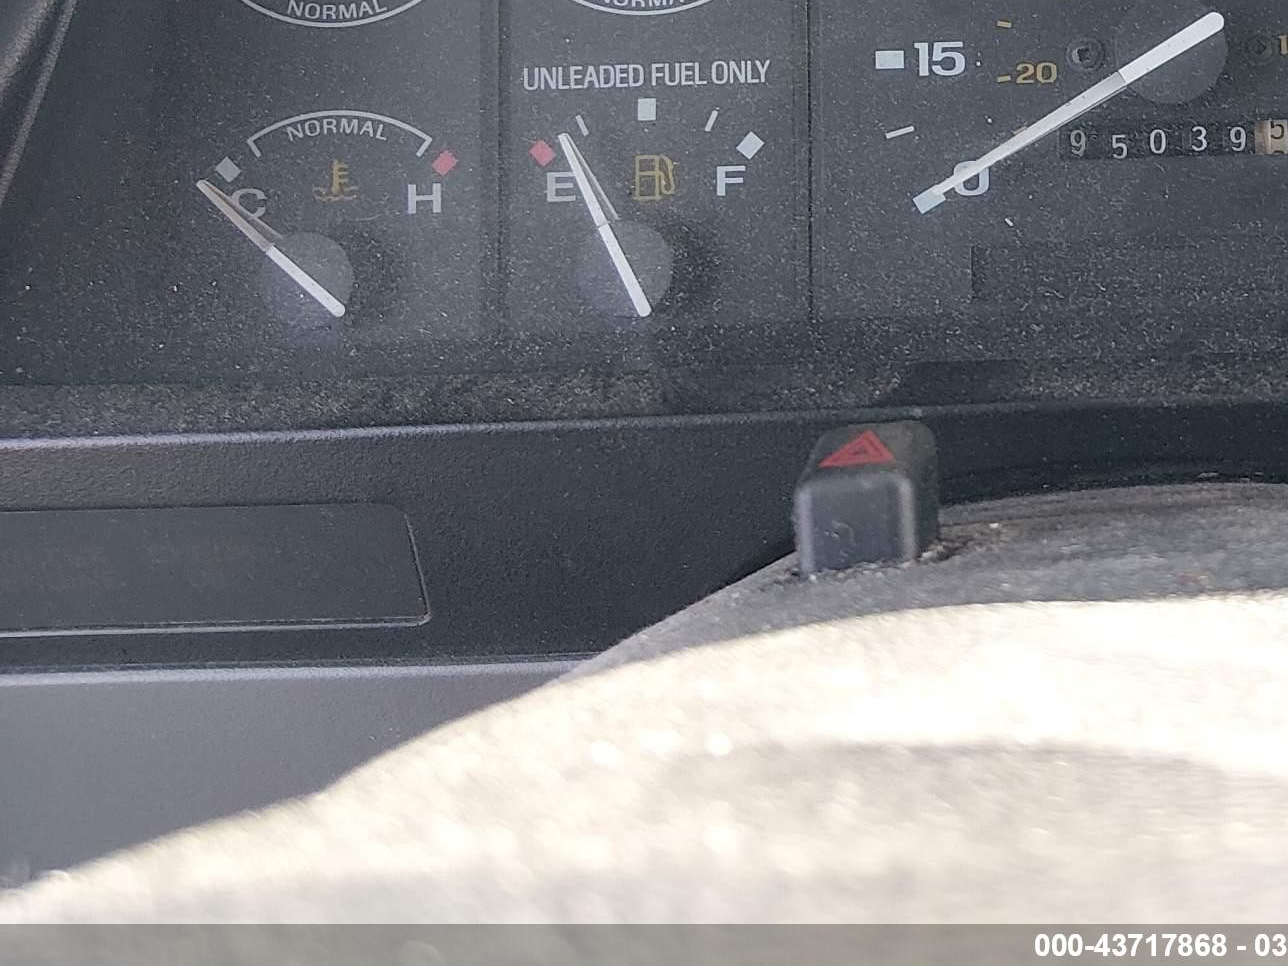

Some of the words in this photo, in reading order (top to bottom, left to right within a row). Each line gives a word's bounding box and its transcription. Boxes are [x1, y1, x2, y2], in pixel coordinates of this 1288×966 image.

[287, 0, 387, 20] NORMAL
[915, 42, 965, 76] 15
[1016, 63, 1057, 83] 20
[523, 64, 645, 91] UNLEADED
[651, 62, 707, 87] FUEL
[711, 59, 771, 84] ONLY
[286, 118, 388, 141] NORMAL
[546, 171, 577, 203] E
[717, 166, 745, 196] F
[953, 160, 990, 196] 0
[231, 188, 267, 219] C
[407, 184, 441, 214] H
